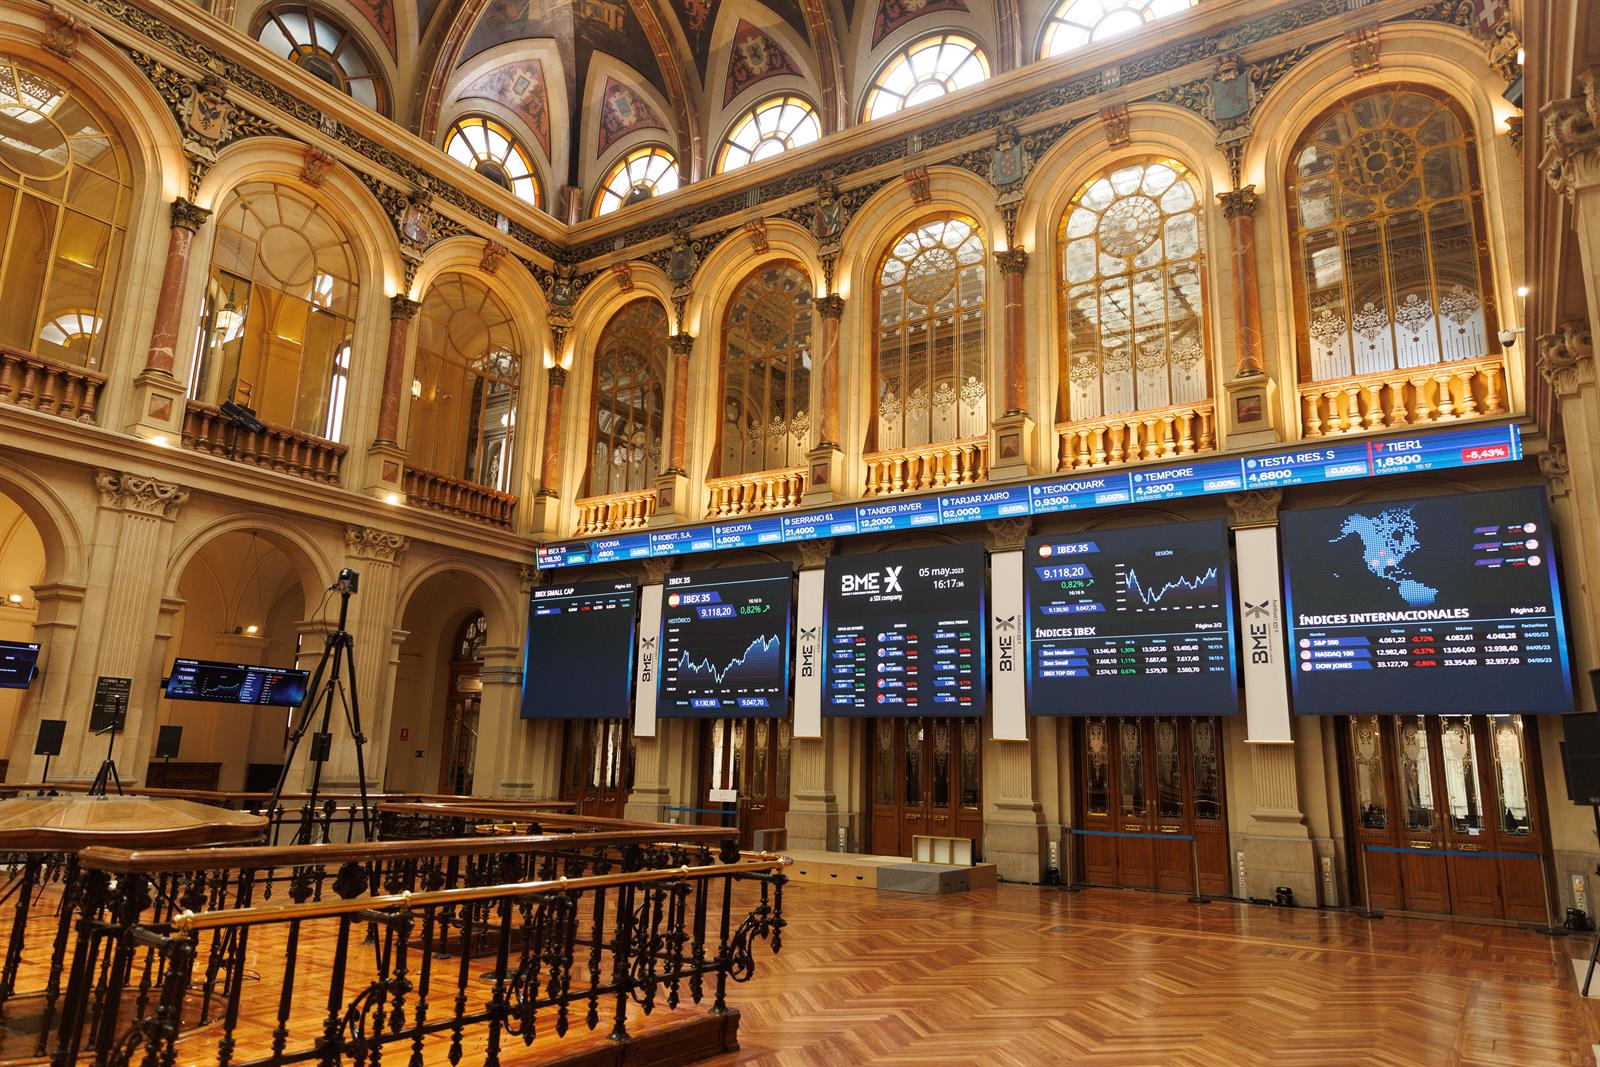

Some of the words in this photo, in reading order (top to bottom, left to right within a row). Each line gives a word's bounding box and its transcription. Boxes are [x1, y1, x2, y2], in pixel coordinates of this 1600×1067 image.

[1387, 440, 1422, 452] TIER1
[1258, 456, 1294, 467] TESTA
[1297, 452, 1323, 463] RES.
[1326, 451, 1335, 459] S
[1376, 454, 1421, 468] 1,8300
[1466, 449, 1504, 459] -5,43%
[1144, 468, 1193, 481] TEMPORE
[1249, 470, 1291, 482] 4,6800
[1331, 465, 1361, 474] 0,00%
[1042, 480, 1105, 494] TECNOQUARK
[1136, 484, 1174, 495] 4,3200
[950, 496, 982, 505] TARJAR
[984, 492, 1009, 501] XAIRO
[1034, 496, 1068, 507] 0,9300
[867, 507, 897, 515] TANDER
[943, 507, 980, 517] 62,0000
[791, 516, 824, 525] SERRANO
[861, 518, 892, 527] 12,2000
[722, 525, 752, 533] SECUOYA
[786, 527, 814, 536] 21,4000
[600, 540, 620, 549] QUONIA
[1058, 545, 1077, 554] IBEX
[1078, 544, 1088, 552] 35
[919, 568, 930, 577] 05
[1044, 567, 1084, 578] 9.118,20
[842, 572, 880, 592] BME
[1062, 580, 1084, 588] 0,82%
[547, 589, 563, 597] SMALL
[882, 594, 902, 602] company
[683, 595, 700, 604] IBEX
[701, 594, 710, 602] 35
[702, 608, 731, 617] 9.118,20
[740, 606, 761, 615] 0,82%
[1299, 613, 1347, 625] ÍNDICES
[1350, 608, 1470, 623] INTERNACIONALES
[1035, 627, 1072, 638] ÍNDICES
[1074, 626, 1096, 636] IBEX
[1250, 624, 1268, 664] BME
[999, 636, 1012, 671] BME
[802, 645, 812, 677] BME
[642, 653, 651, 682] BME
